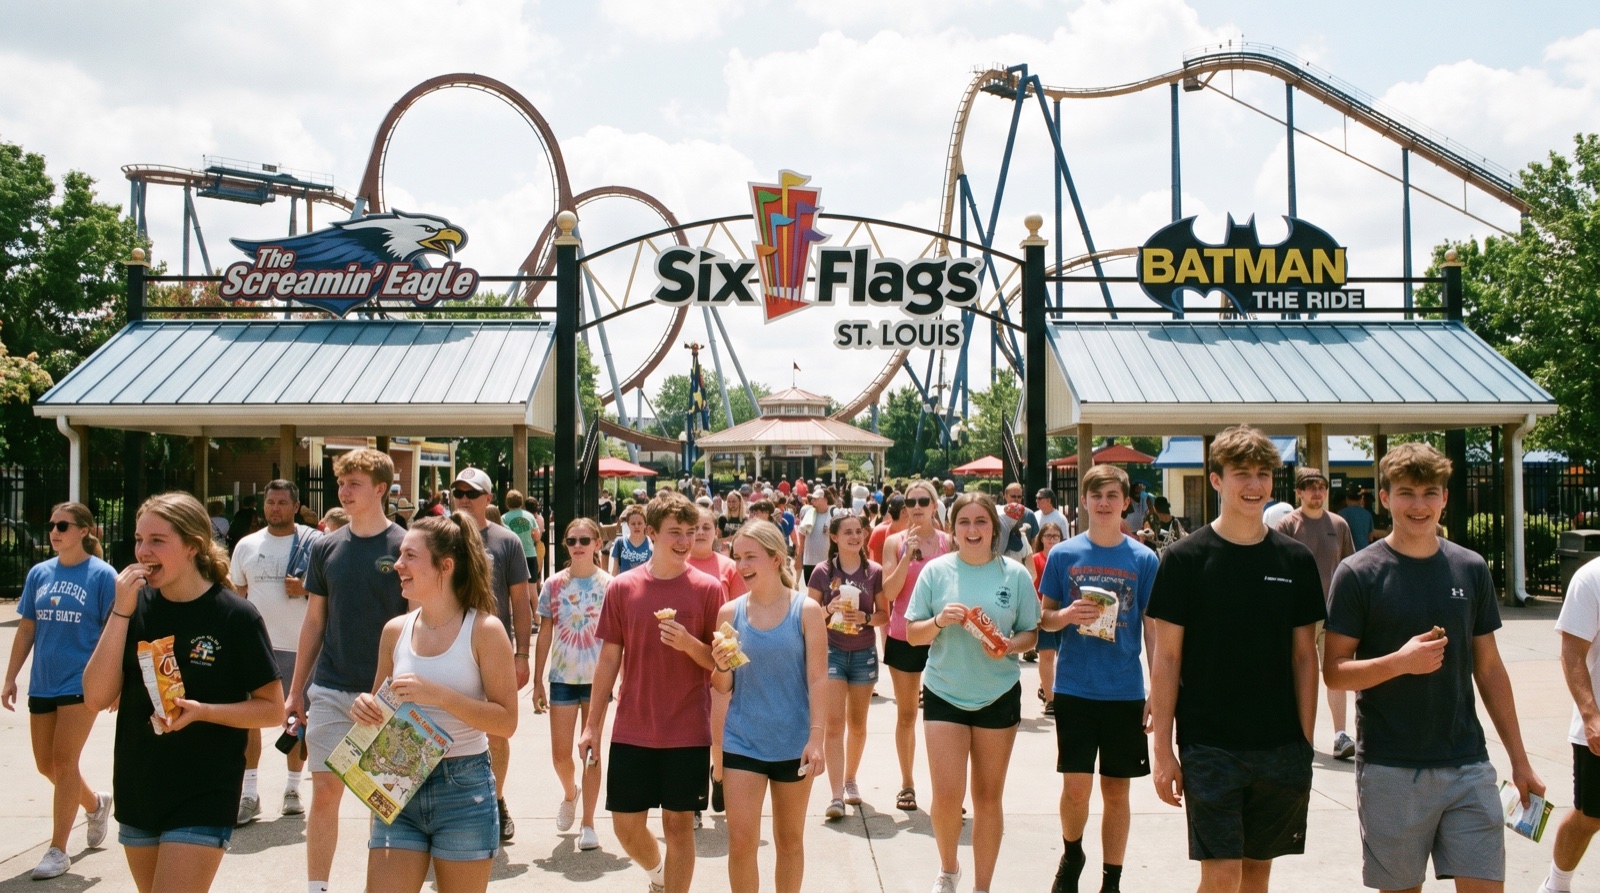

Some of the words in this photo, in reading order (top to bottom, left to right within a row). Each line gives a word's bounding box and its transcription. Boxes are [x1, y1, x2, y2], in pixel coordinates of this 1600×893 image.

[257, 248, 294, 269] The
[1142, 248, 1346, 284] BATMAN
[222, 264, 384, 296] Screamin'
[382, 263, 473, 301] Eagle
[655, 249, 756, 303] Six
[818, 248, 978, 315] Flags
[1252, 291, 1299, 309] THE
[1306, 291, 1363, 309] RIDE
[837, 323, 872, 346] ST.
[882, 323, 960, 346] LOUIS
